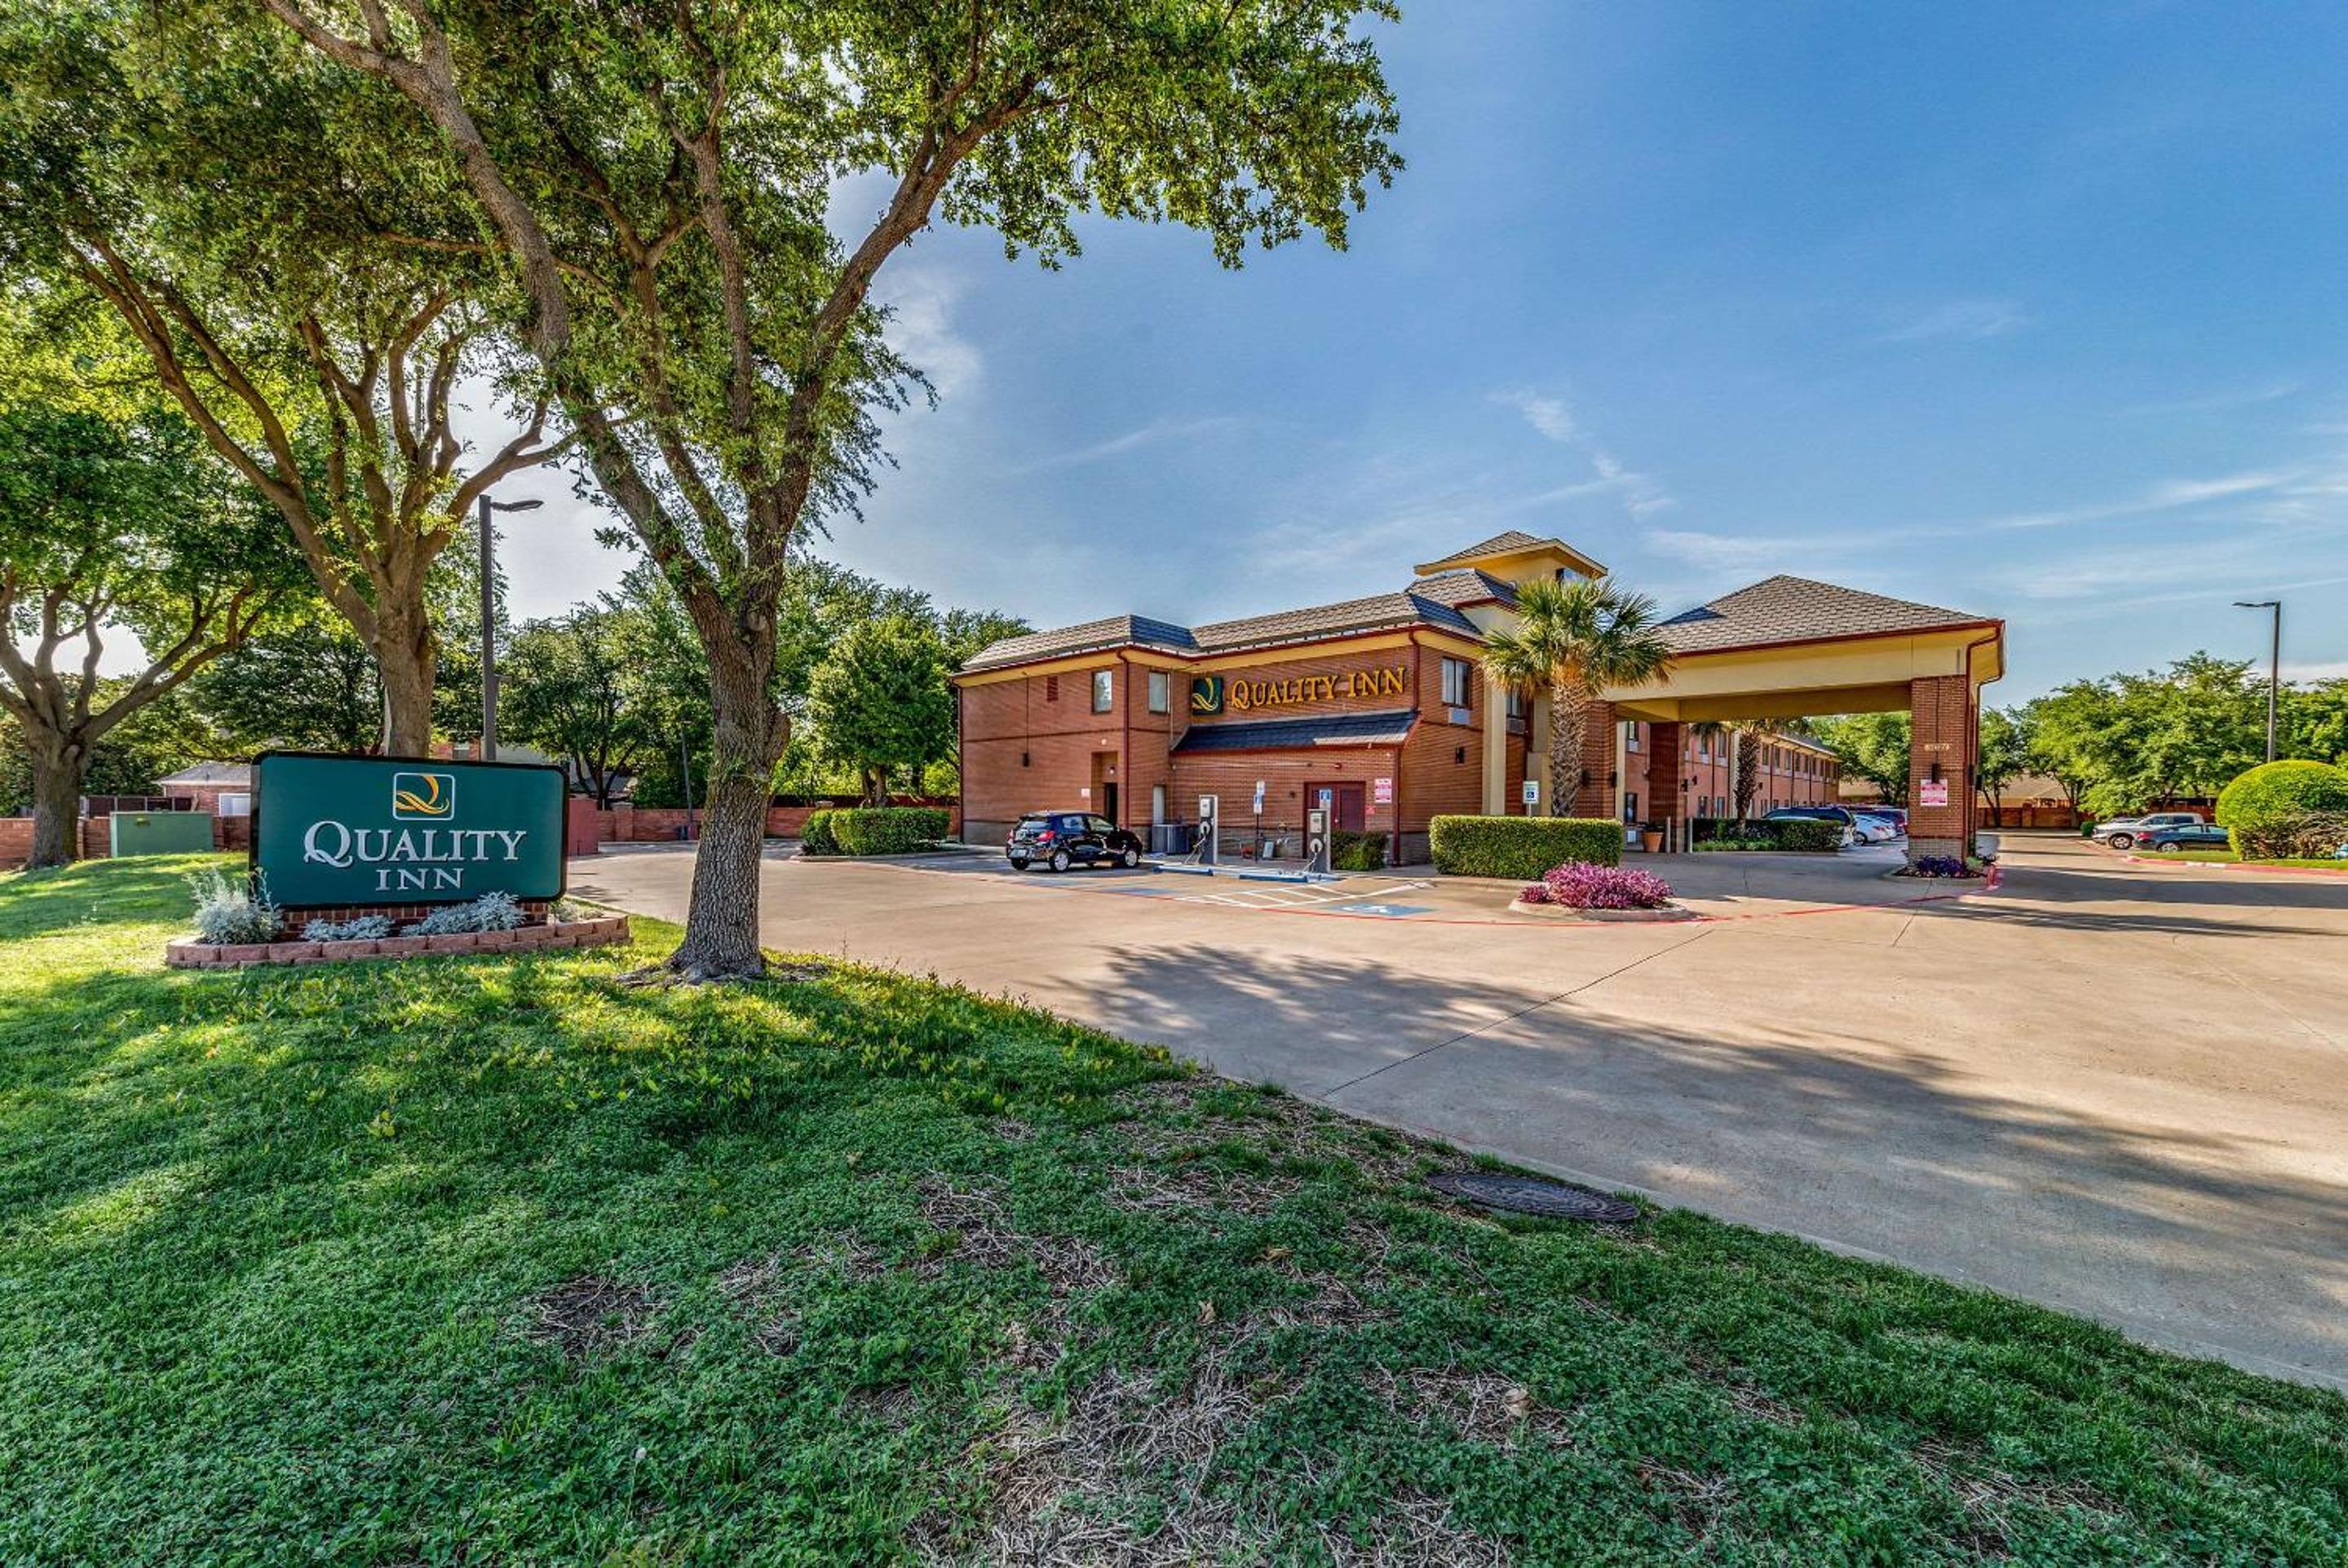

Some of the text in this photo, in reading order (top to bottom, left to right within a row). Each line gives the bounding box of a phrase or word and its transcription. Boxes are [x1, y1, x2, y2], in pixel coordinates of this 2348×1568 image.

[1230, 667, 1405, 709] QUALITY INN
[304, 820, 526, 868] QUALITY
[375, 868, 463, 891] INN
